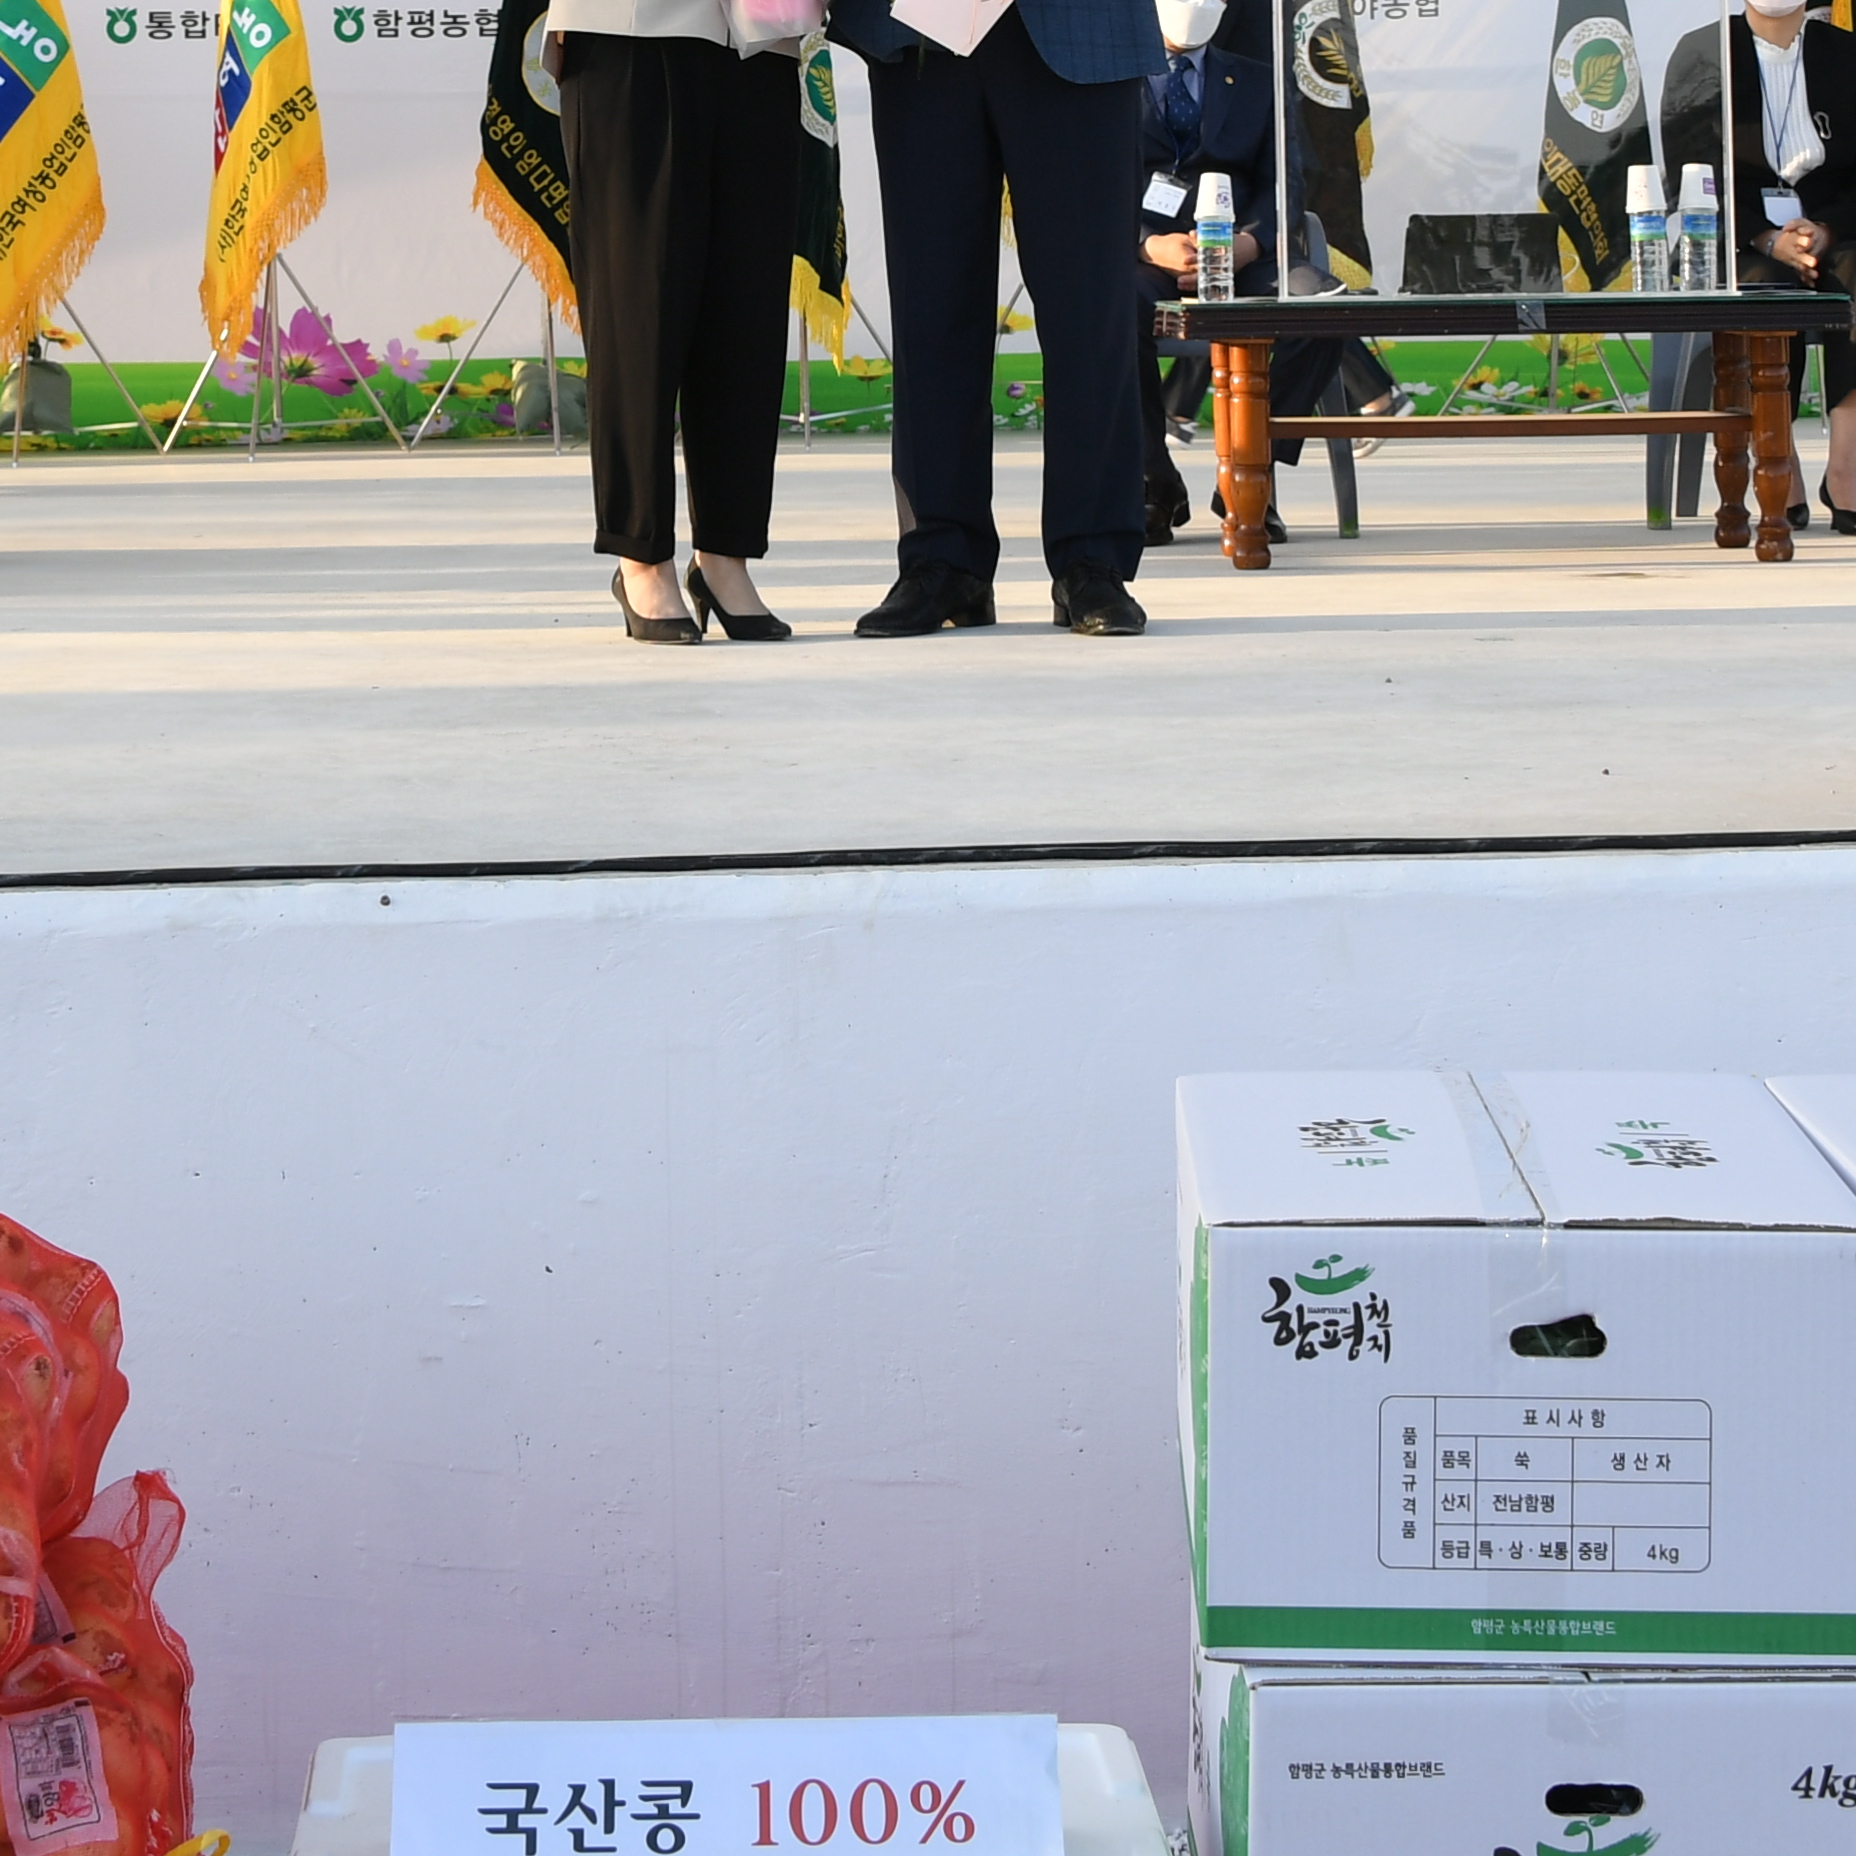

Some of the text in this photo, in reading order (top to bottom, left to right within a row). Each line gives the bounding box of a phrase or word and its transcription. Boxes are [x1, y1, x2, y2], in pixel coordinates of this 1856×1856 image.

[1439, 1450, 1473, 1471] 품목
[1513, 1451, 1532, 1472] 쑥
[1440, 1491, 1557, 1515] 산지 전남함평
[1439, 1539, 1472, 1561] 등급
[1577, 1540, 1609, 1563] 중량
[1646, 1541, 1681, 1565] 4kg
[475, 1776, 978, 1856] 국산콩 100%
